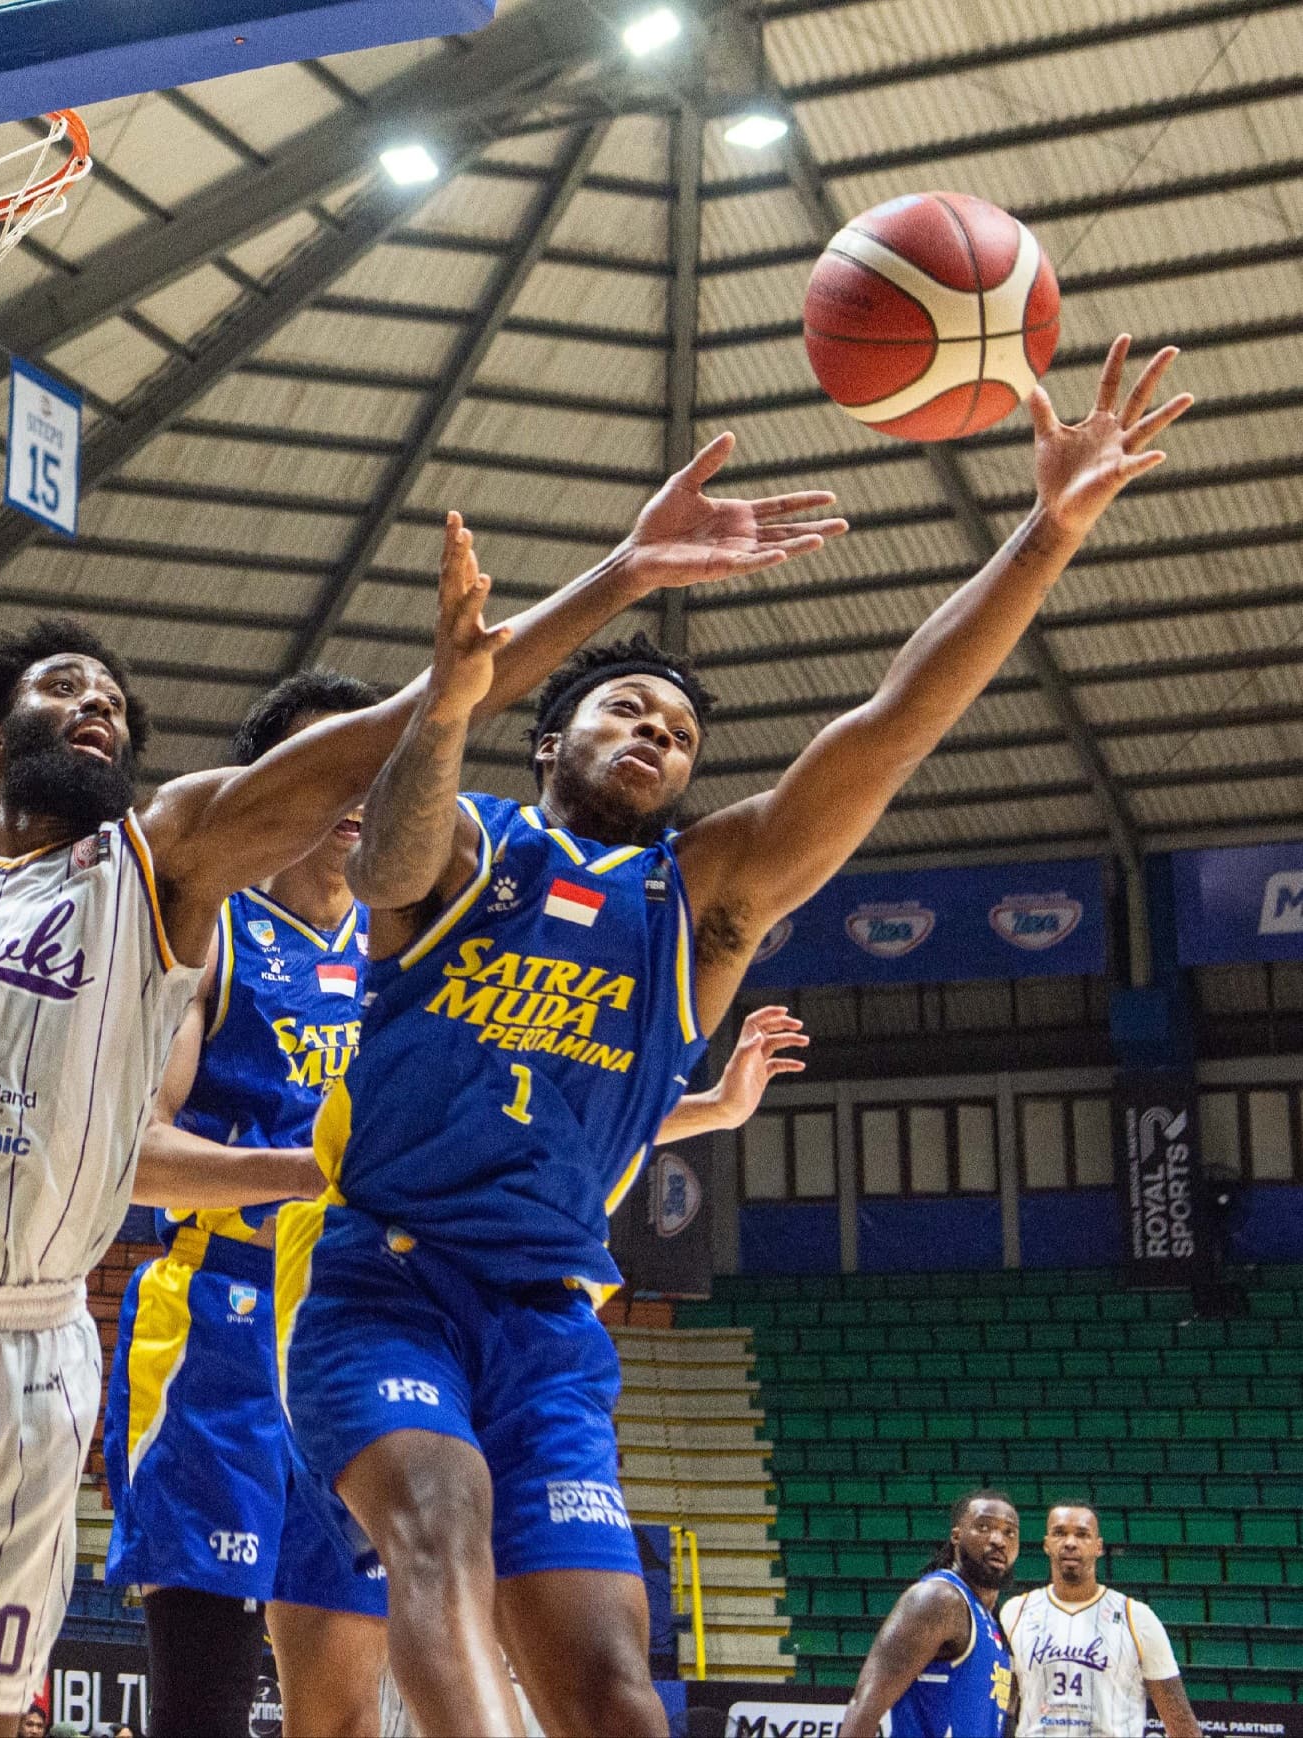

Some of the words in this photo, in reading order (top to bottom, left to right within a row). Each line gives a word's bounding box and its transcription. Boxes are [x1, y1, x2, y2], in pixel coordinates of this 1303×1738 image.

[28, 445, 60, 513] 15
[261, 971, 292, 983] KELME
[442, 937, 636, 1011] SATRIA
[424, 977, 599, 1038] MUDA
[286, 1046, 360, 1088] MU
[477, 1023, 635, 1073] PERTAMINA
[502, 1063, 532, 1124] 1
[1143, 1163, 1170, 1258] ROYAL
[1166, 1143, 1195, 1258] SPORTS
[548, 1489, 614, 1509] ROYAL
[550, 1505, 627, 1530] SPORTS
[1029, 1634, 1112, 1671] Hawks
[1053, 1671, 1083, 1697] 34
[1229, 1721, 1285, 1734] PARTNER
